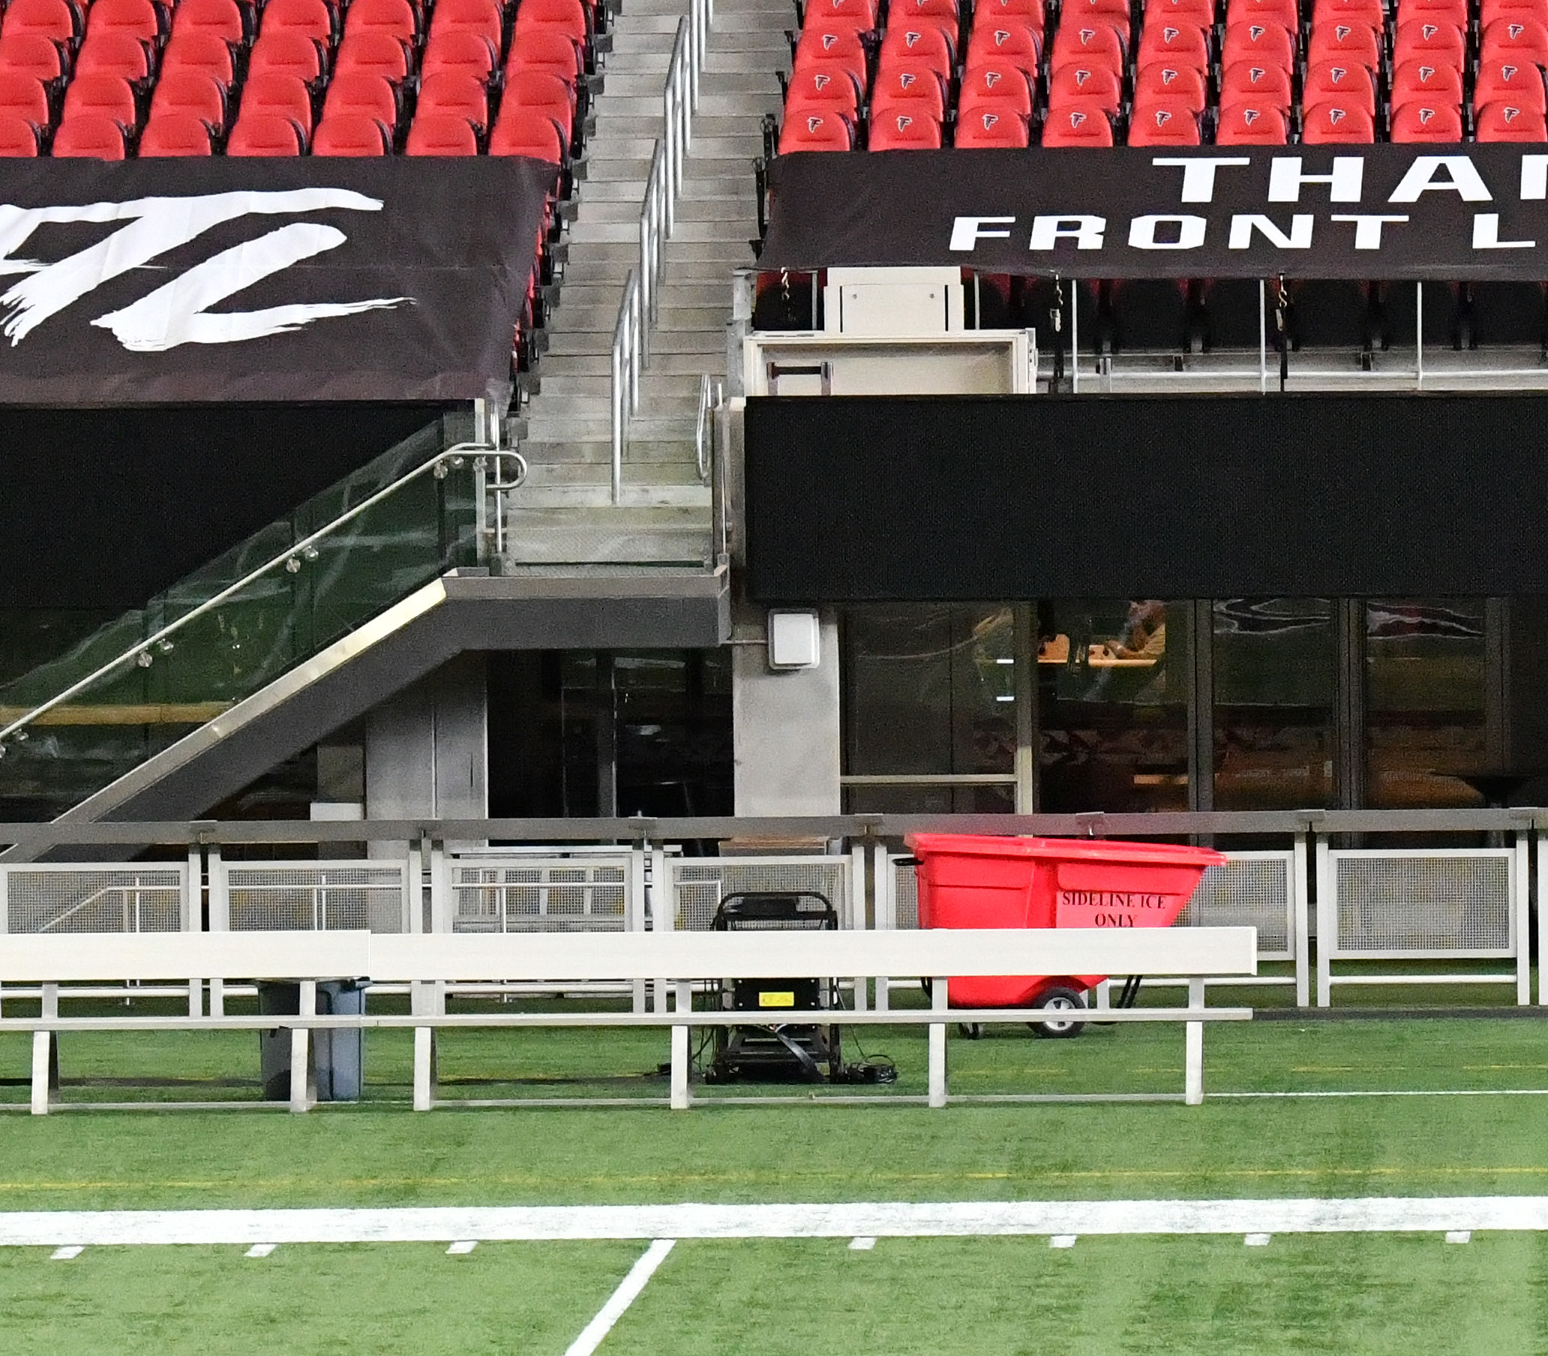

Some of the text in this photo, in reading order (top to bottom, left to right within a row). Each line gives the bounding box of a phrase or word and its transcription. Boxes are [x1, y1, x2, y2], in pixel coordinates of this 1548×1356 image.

[949, 214, 1410, 251] FRONT
[1062, 891, 1167, 910] SIDELINE ICE
[1094, 912, 1137, 928] ONLY
